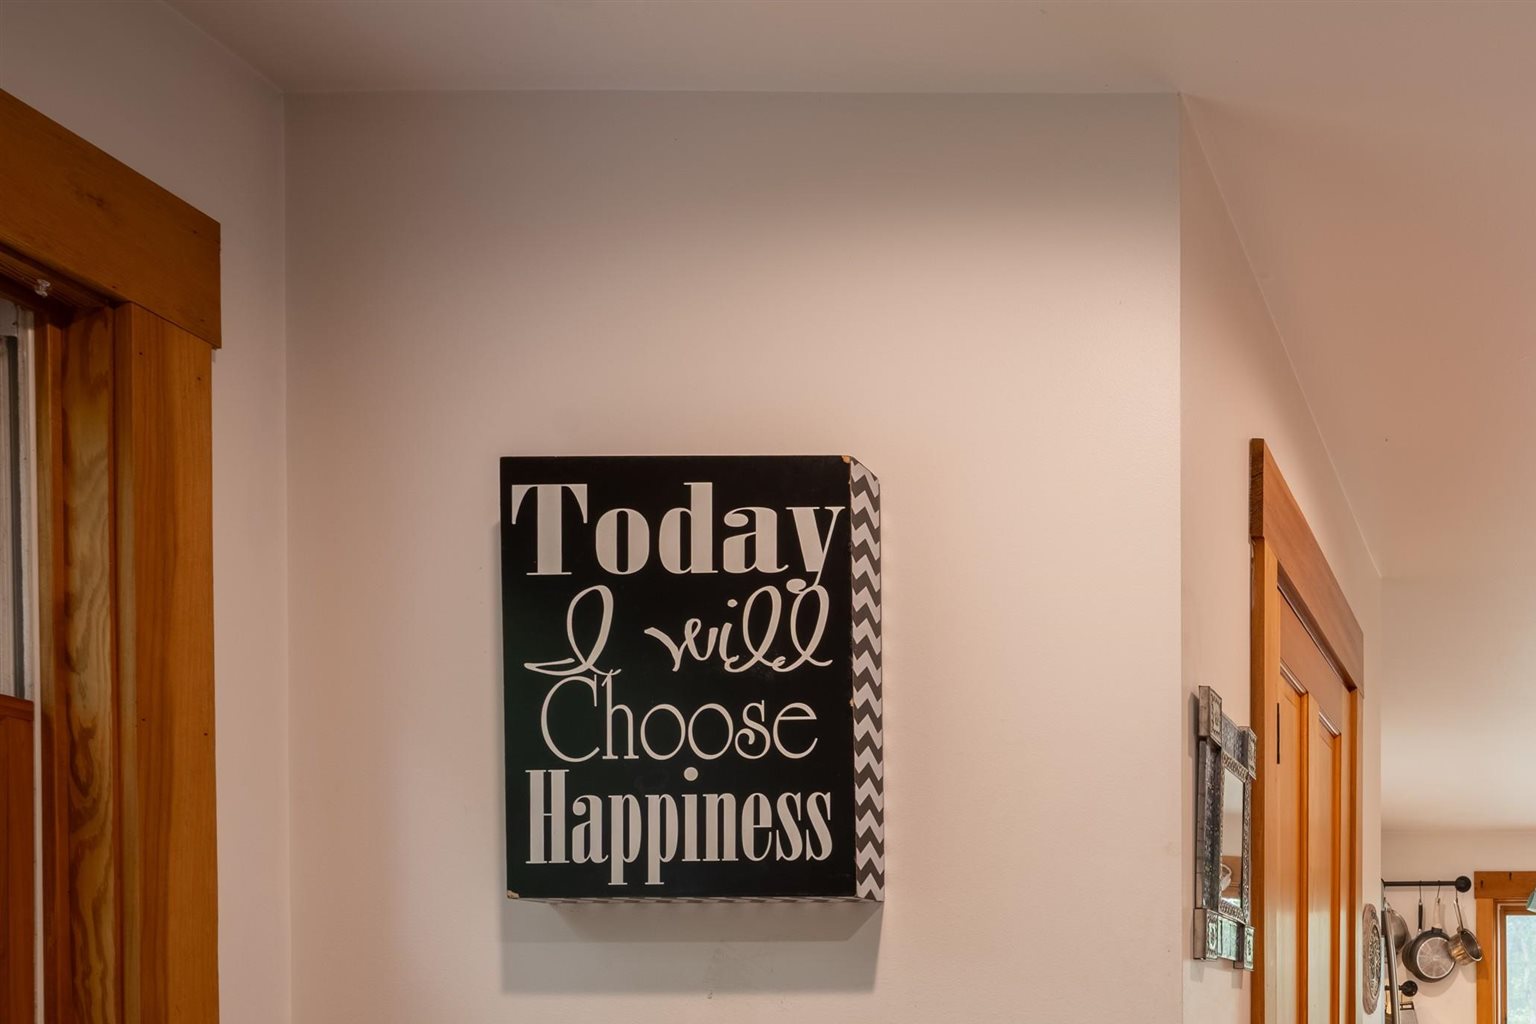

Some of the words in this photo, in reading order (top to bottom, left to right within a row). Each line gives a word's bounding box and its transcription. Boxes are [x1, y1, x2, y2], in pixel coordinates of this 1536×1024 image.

[511, 482, 846, 593] Today
[524, 585, 621, 675] I
[644, 585, 833, 672] will
[541, 669, 818, 763] Choose
[525, 766, 833, 886] Happiness
